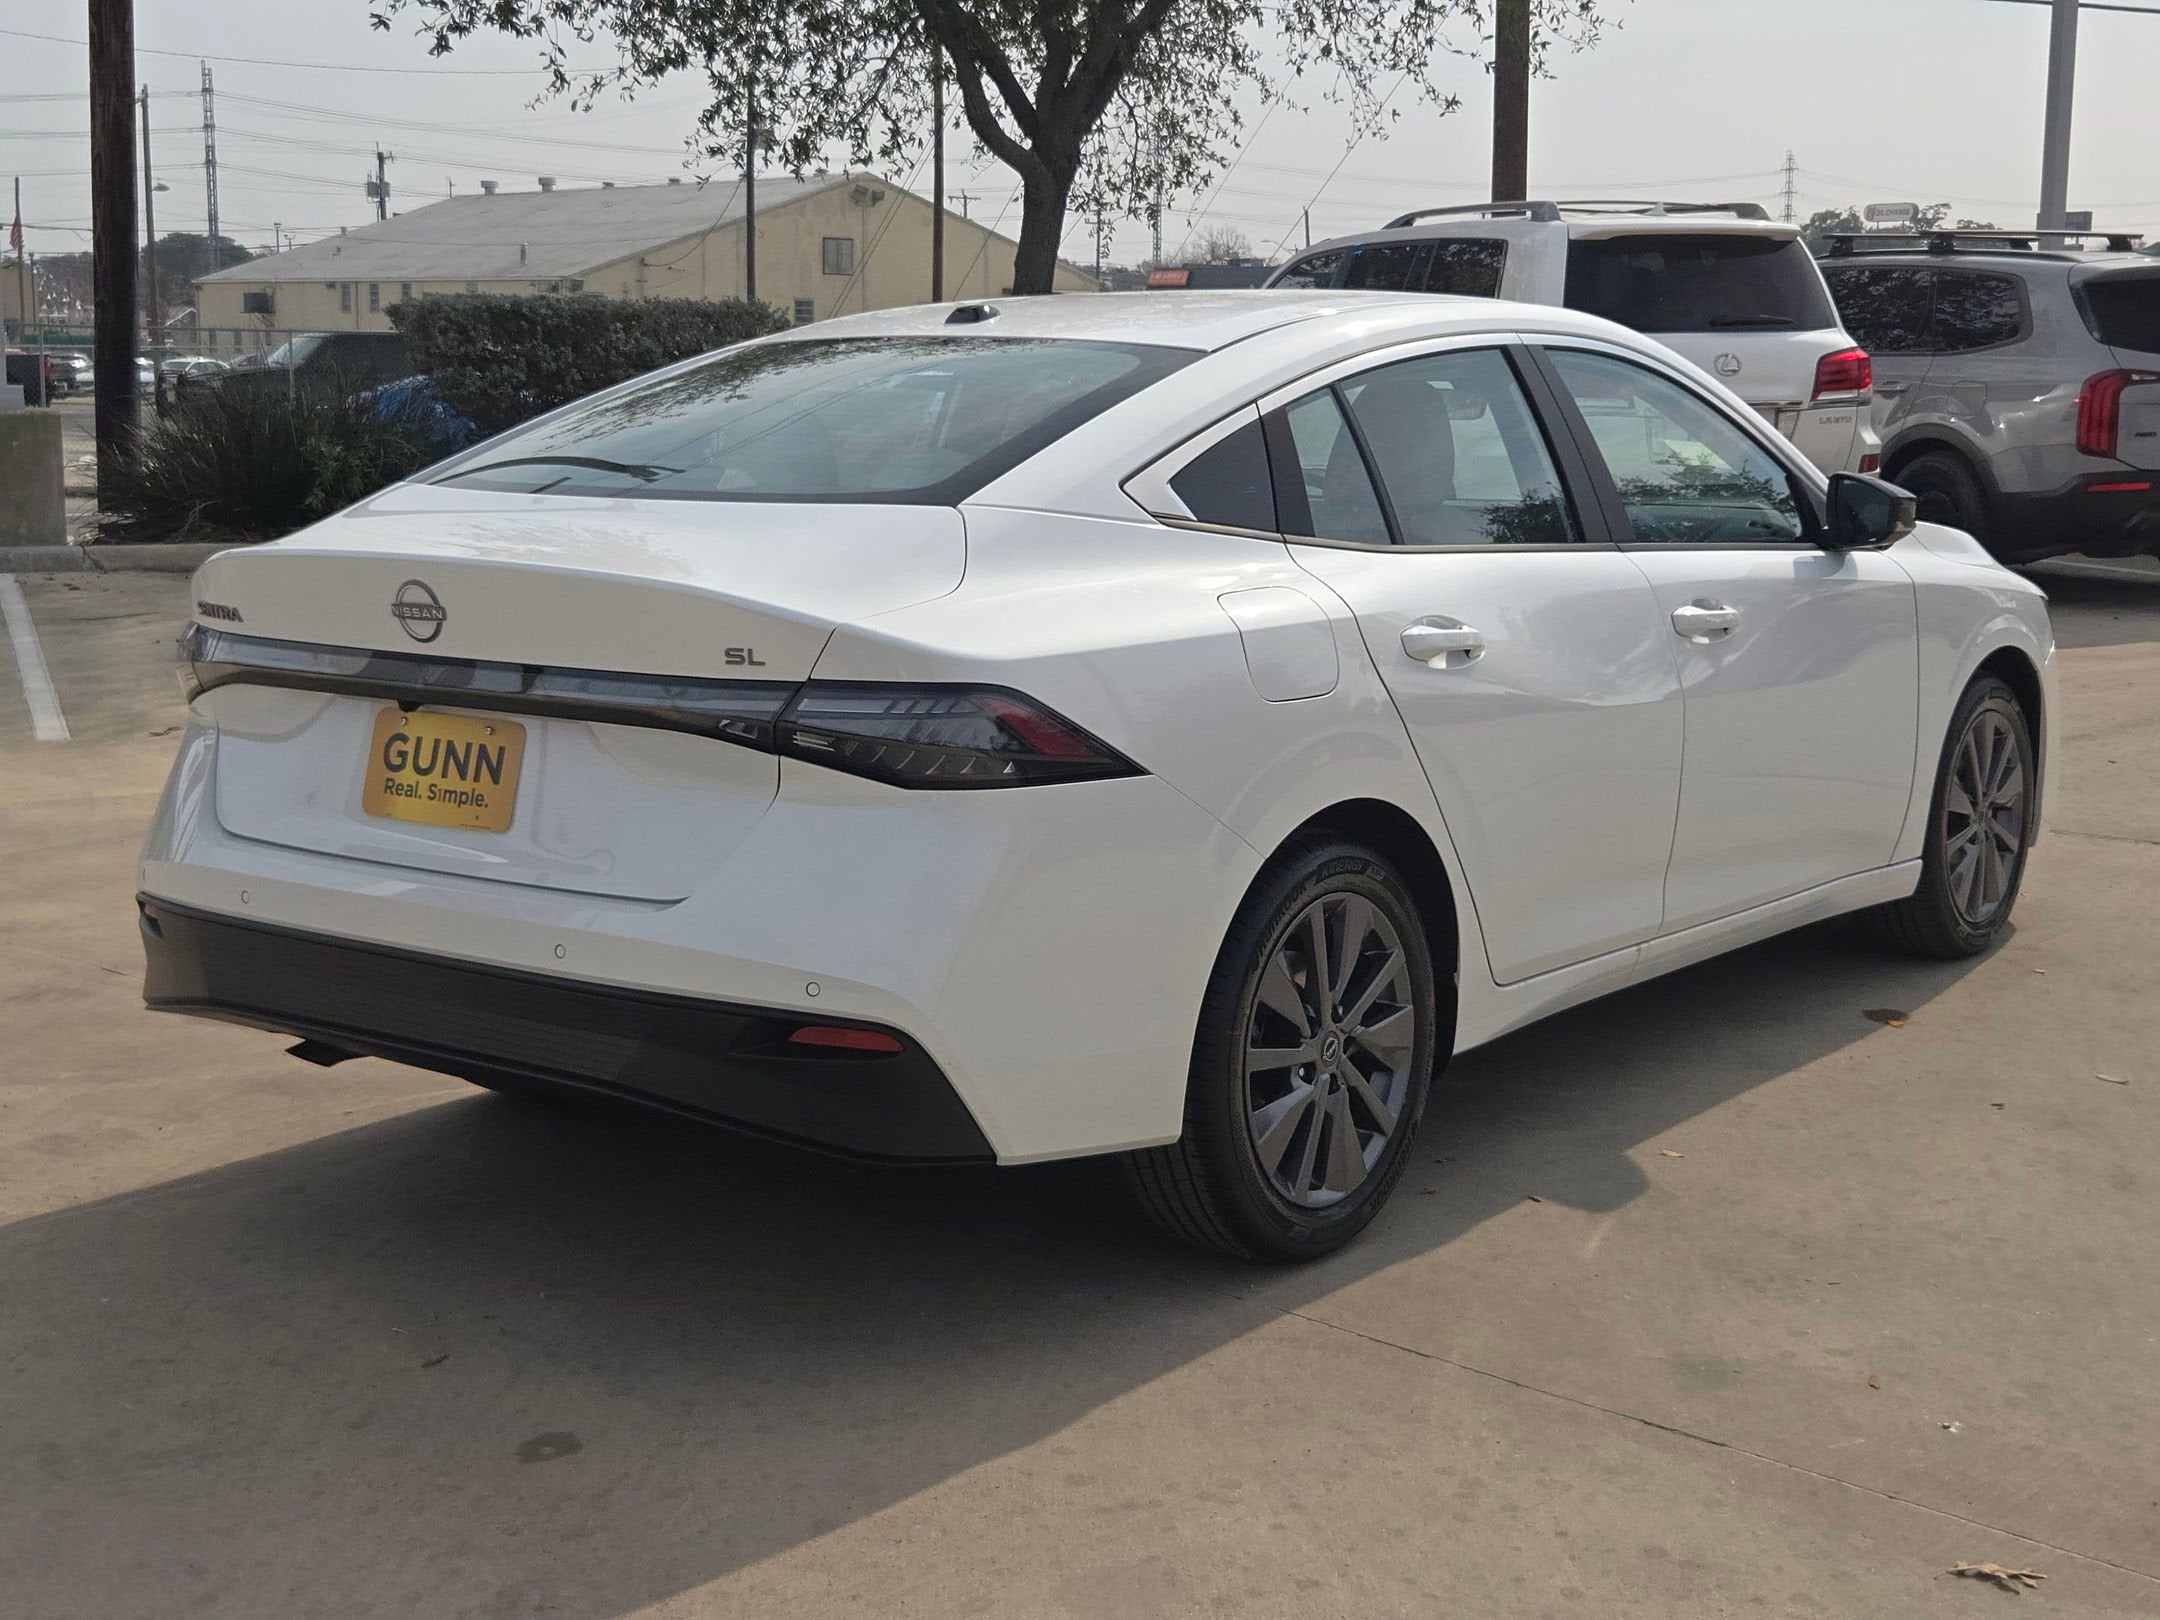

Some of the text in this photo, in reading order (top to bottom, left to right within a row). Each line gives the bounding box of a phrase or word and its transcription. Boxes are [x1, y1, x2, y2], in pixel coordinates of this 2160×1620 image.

[391, 604, 443, 619] NISSAN
[724, 647, 766, 666] SL
[383, 732, 506, 786] GUNN
[384, 777, 422, 800] Real.
